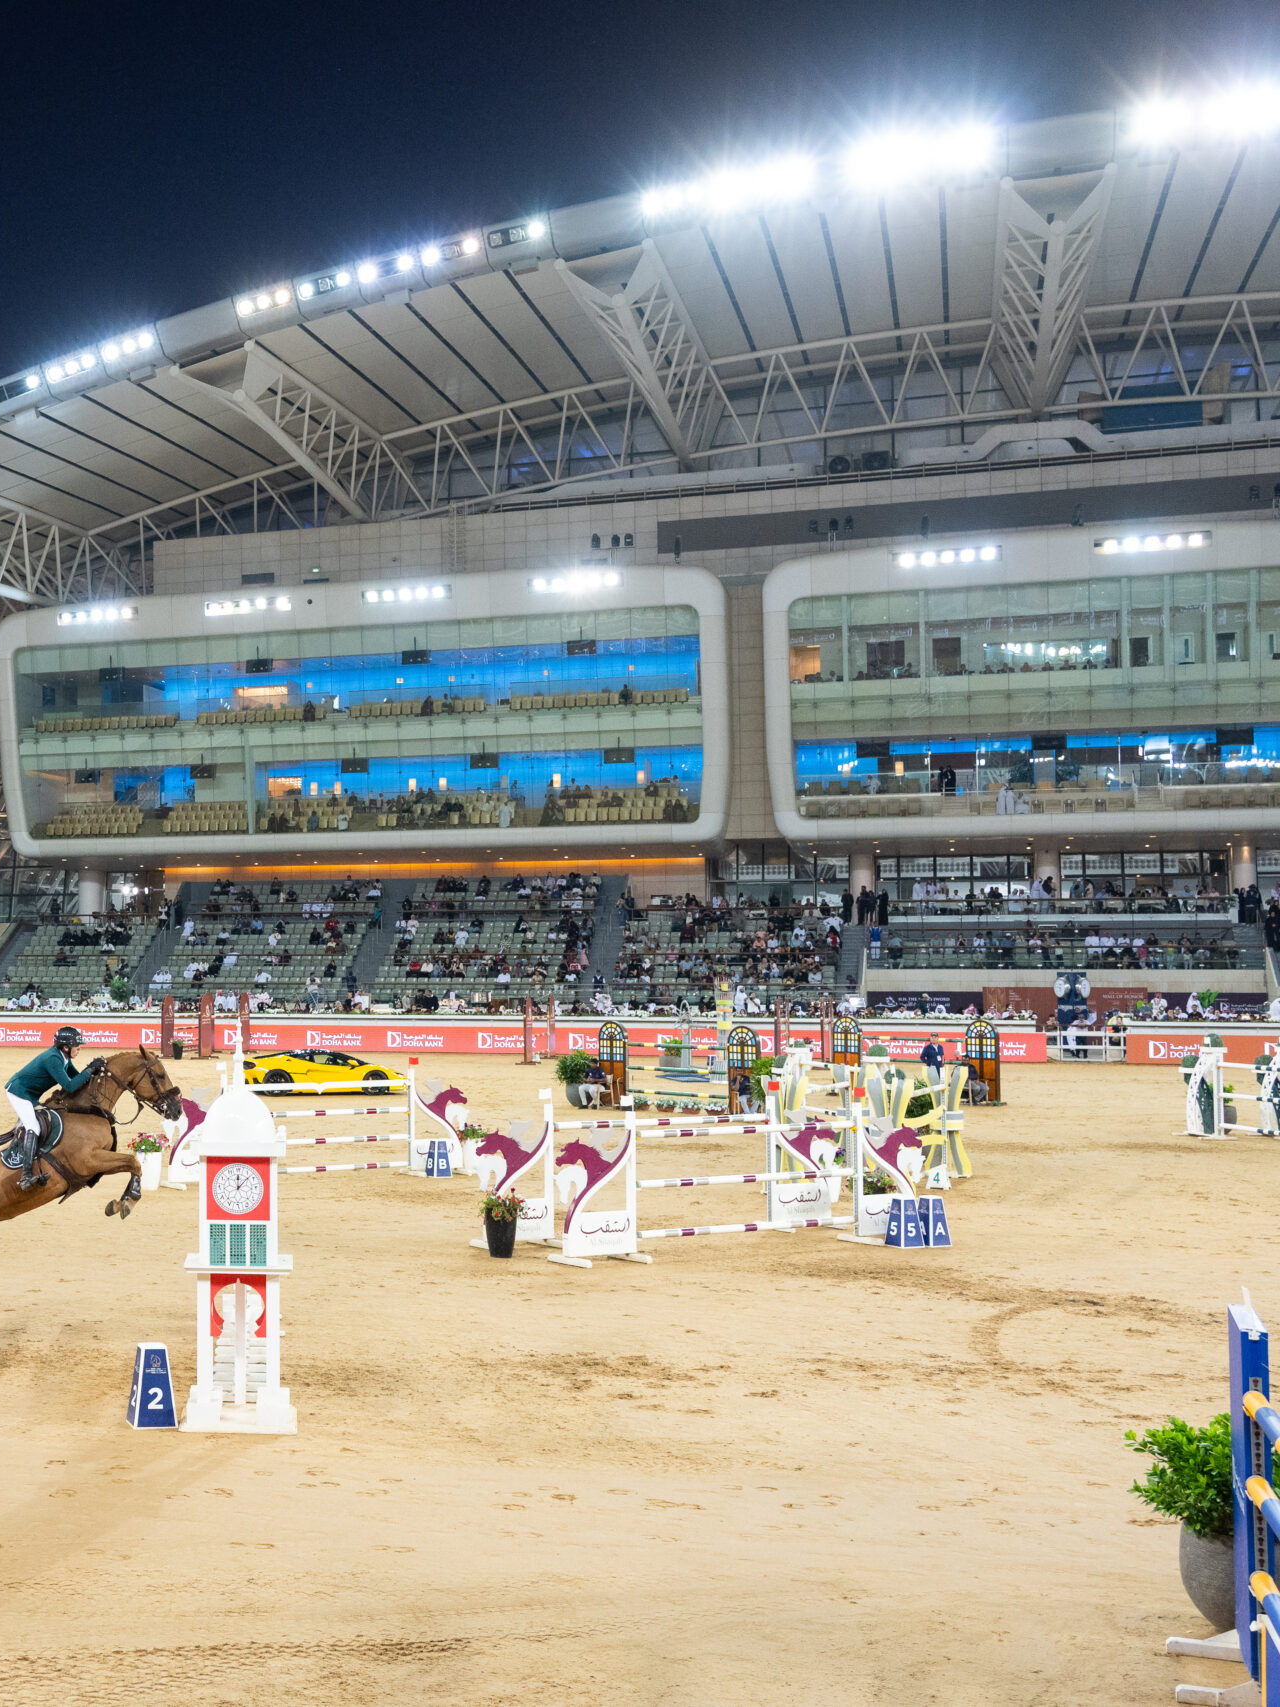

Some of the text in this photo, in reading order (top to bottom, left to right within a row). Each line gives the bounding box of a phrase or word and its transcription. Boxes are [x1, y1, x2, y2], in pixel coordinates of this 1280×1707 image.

[1003, 1047, 1026, 1056] BANK
[428, 1158, 433, 1168] B
[439, 1159, 447, 1169] B
[933, 1172, 940, 1184] 4
[890, 1222, 898, 1236] 5
[907, 1223, 916, 1237] 5
[935, 1224, 946, 1236] A
[131, 1385, 138, 1407] 2
[147, 1387, 164, 1410] 2
